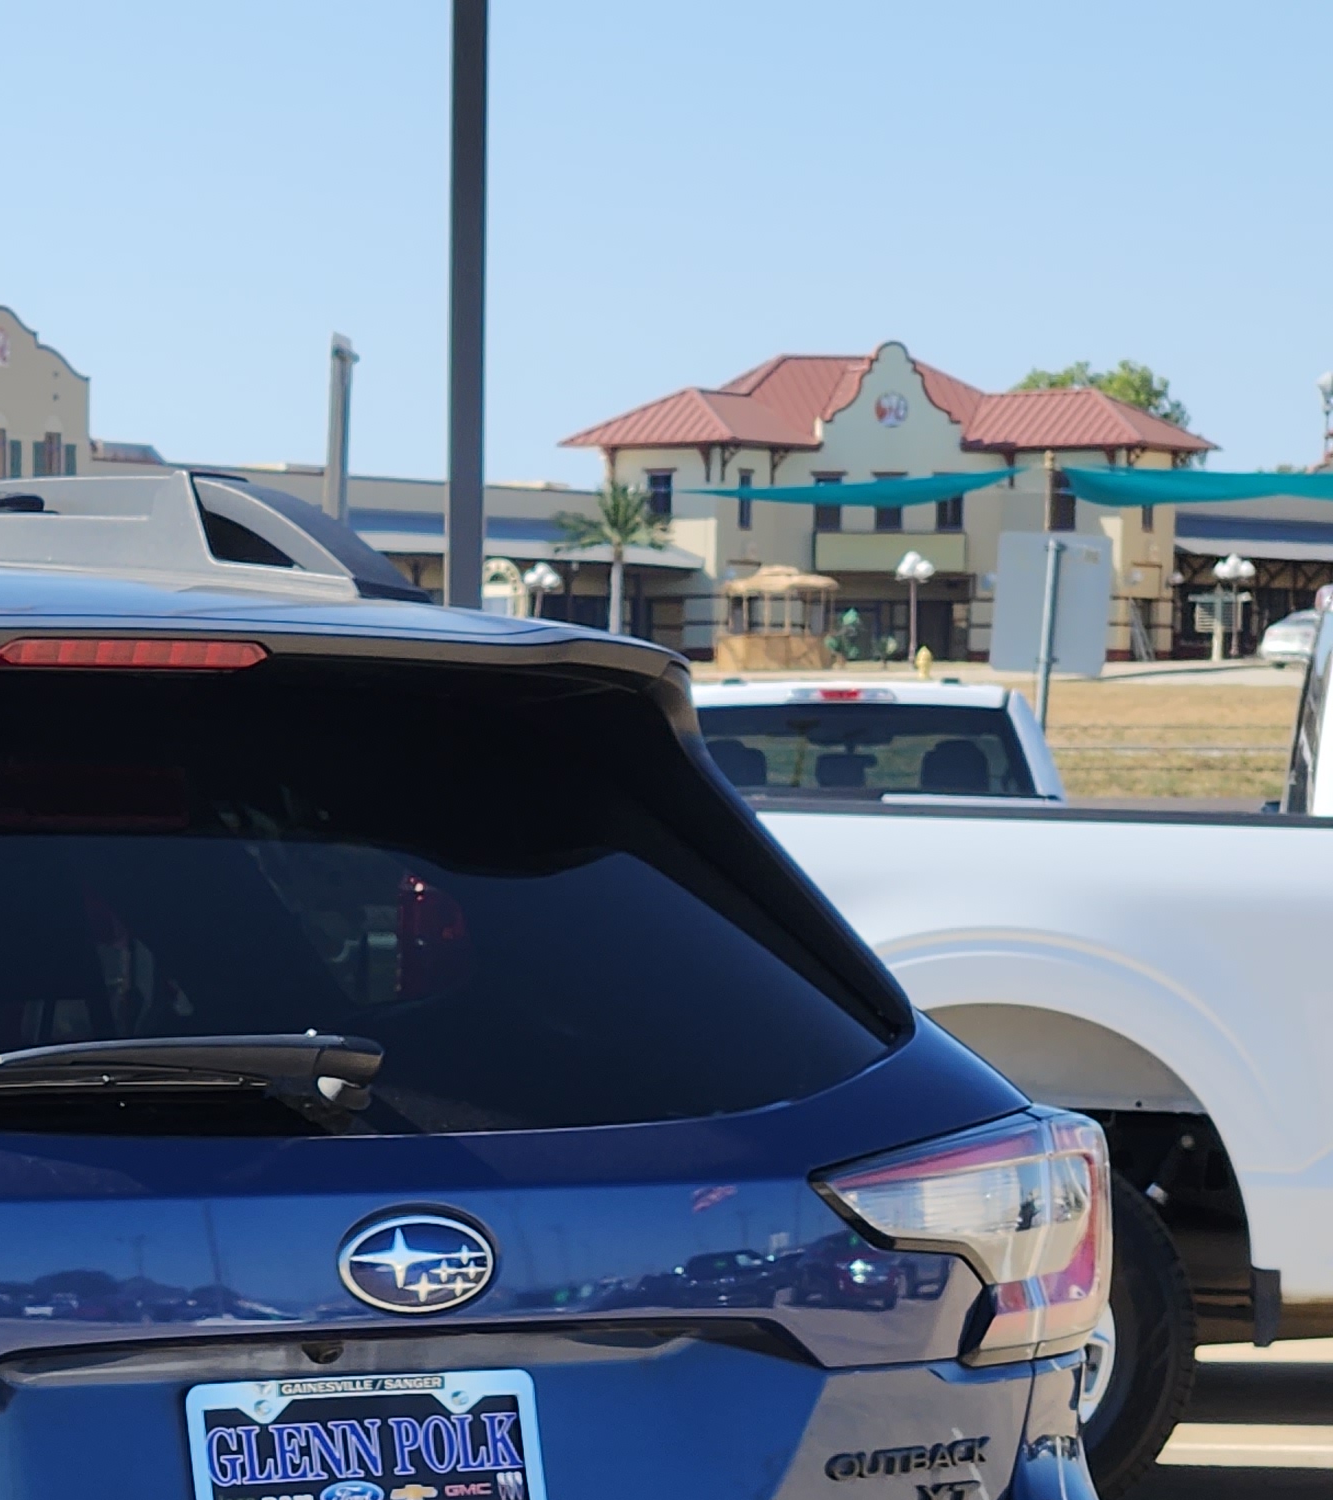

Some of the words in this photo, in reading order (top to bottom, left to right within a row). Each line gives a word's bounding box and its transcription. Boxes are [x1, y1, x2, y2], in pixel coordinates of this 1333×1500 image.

[280, 1379, 373, 1396] GAINESVILLE
[384, 1376, 443, 1390] SANGER
[206, 1418, 383, 1487] GLENN
[388, 1412, 524, 1475] POLK
[824, 1436, 990, 1481] OUTBACK
[444, 1483, 493, 1497] GMC
